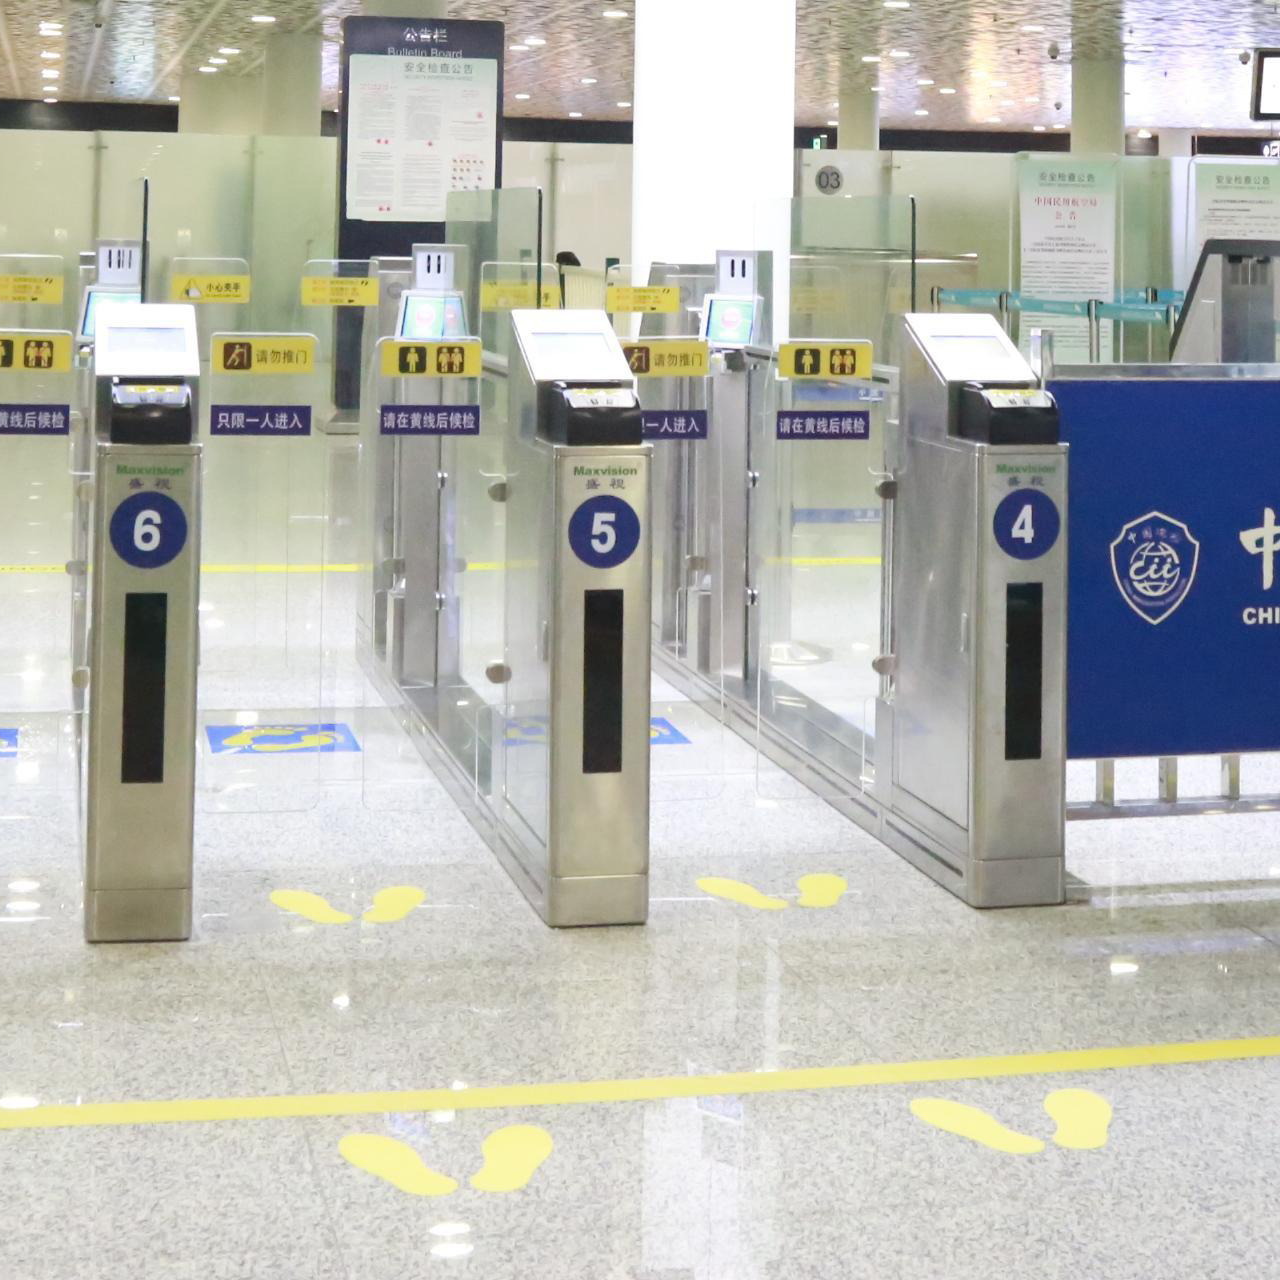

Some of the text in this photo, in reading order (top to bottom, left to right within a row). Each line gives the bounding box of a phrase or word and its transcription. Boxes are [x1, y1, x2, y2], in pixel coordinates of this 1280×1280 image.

[403, 27, 449, 43] 公告栏
[430, 47, 463, 59] Board
[404, 61, 473, 74] 安全检查公告
[818, 171, 840, 189] 03
[256, 349, 308, 365] 请勿推门
[654, 352, 704, 368] 请勿推门
[216, 412, 303, 429] 只限一人进入
[383, 412, 476, 429] 请在黄线后候检
[641, 417, 700, 432] 一人进入
[779, 417, 866, 434] 请在黄线后候检
[573, 466, 638, 476] Maxvision
[133, 509, 162, 552] 6
[1011, 504, 1035, 544] 4
[590, 512, 617, 554] 5
